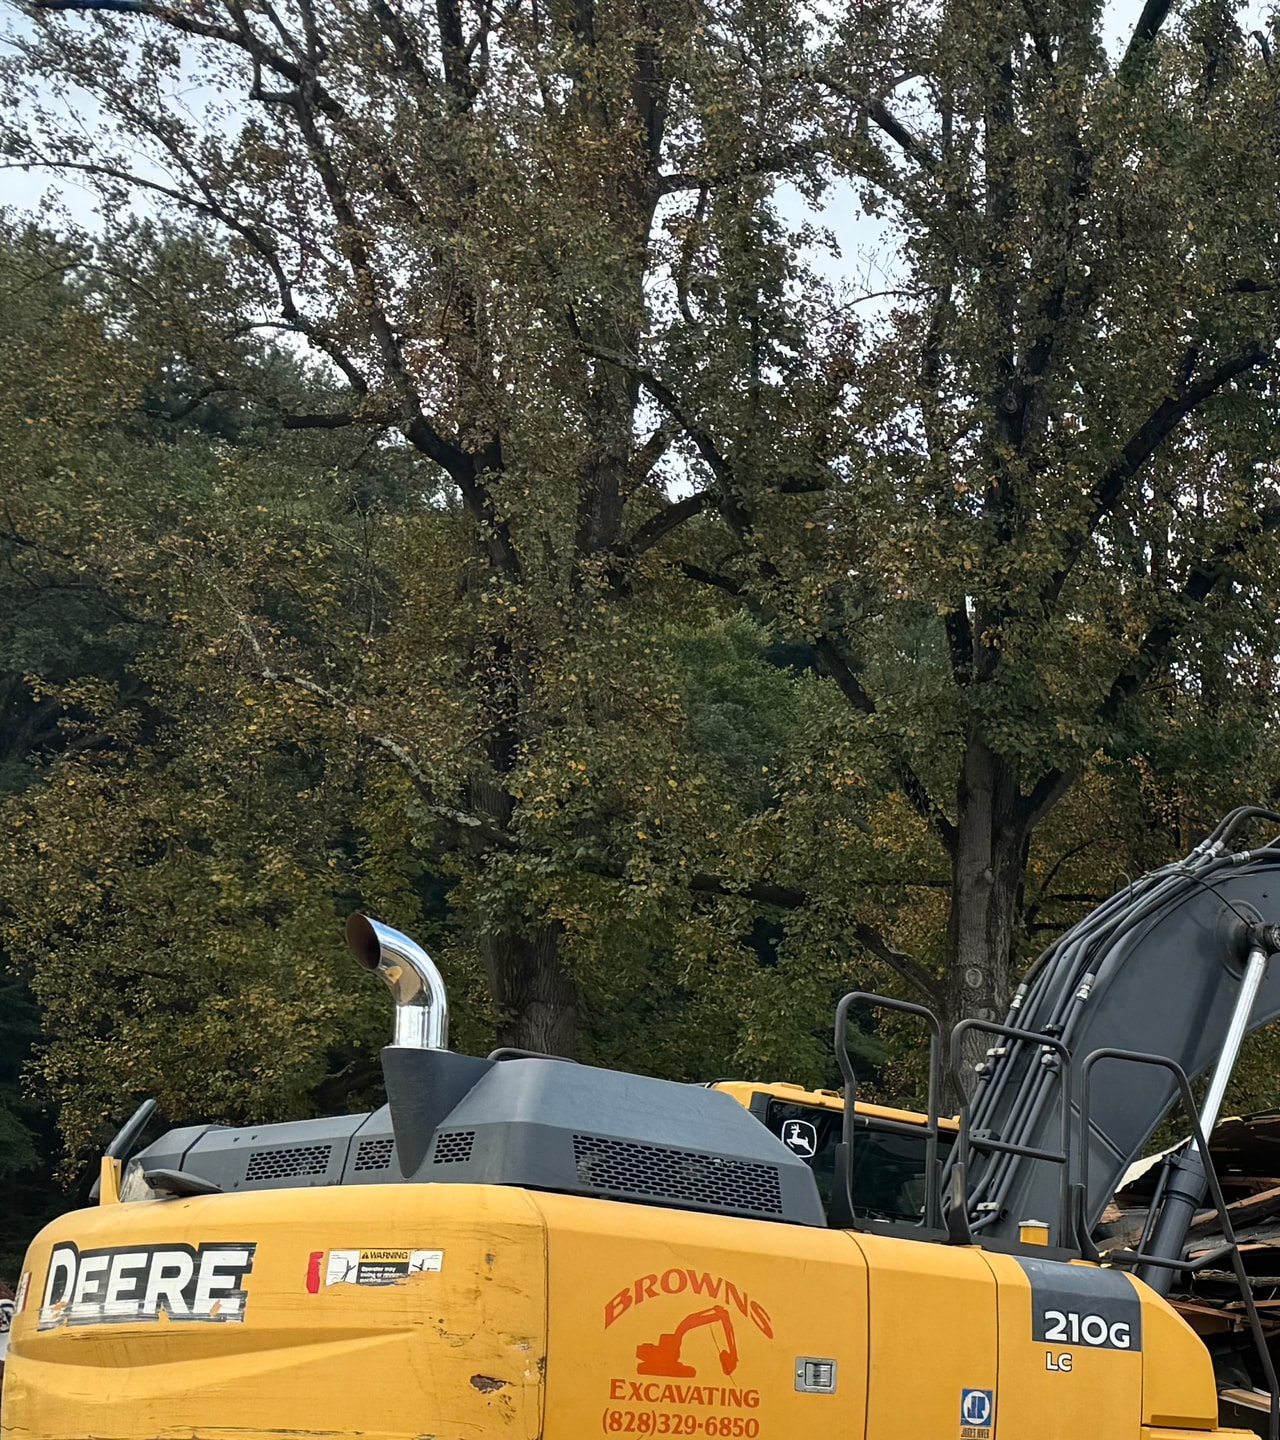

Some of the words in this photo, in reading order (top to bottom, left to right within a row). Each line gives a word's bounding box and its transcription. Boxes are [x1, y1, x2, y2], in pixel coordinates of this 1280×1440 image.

[370, 1251, 408, 1260] WARNING
[41, 1248, 249, 1322] DEERE
[604, 1268, 774, 1340] BROWNS
[1044, 1310, 1130, 1348] 210G
[1045, 1351, 1073, 1372] LC
[609, 1378, 760, 1408] EXCAVATING
[602, 1407, 760, 1438] (828)329-6850
